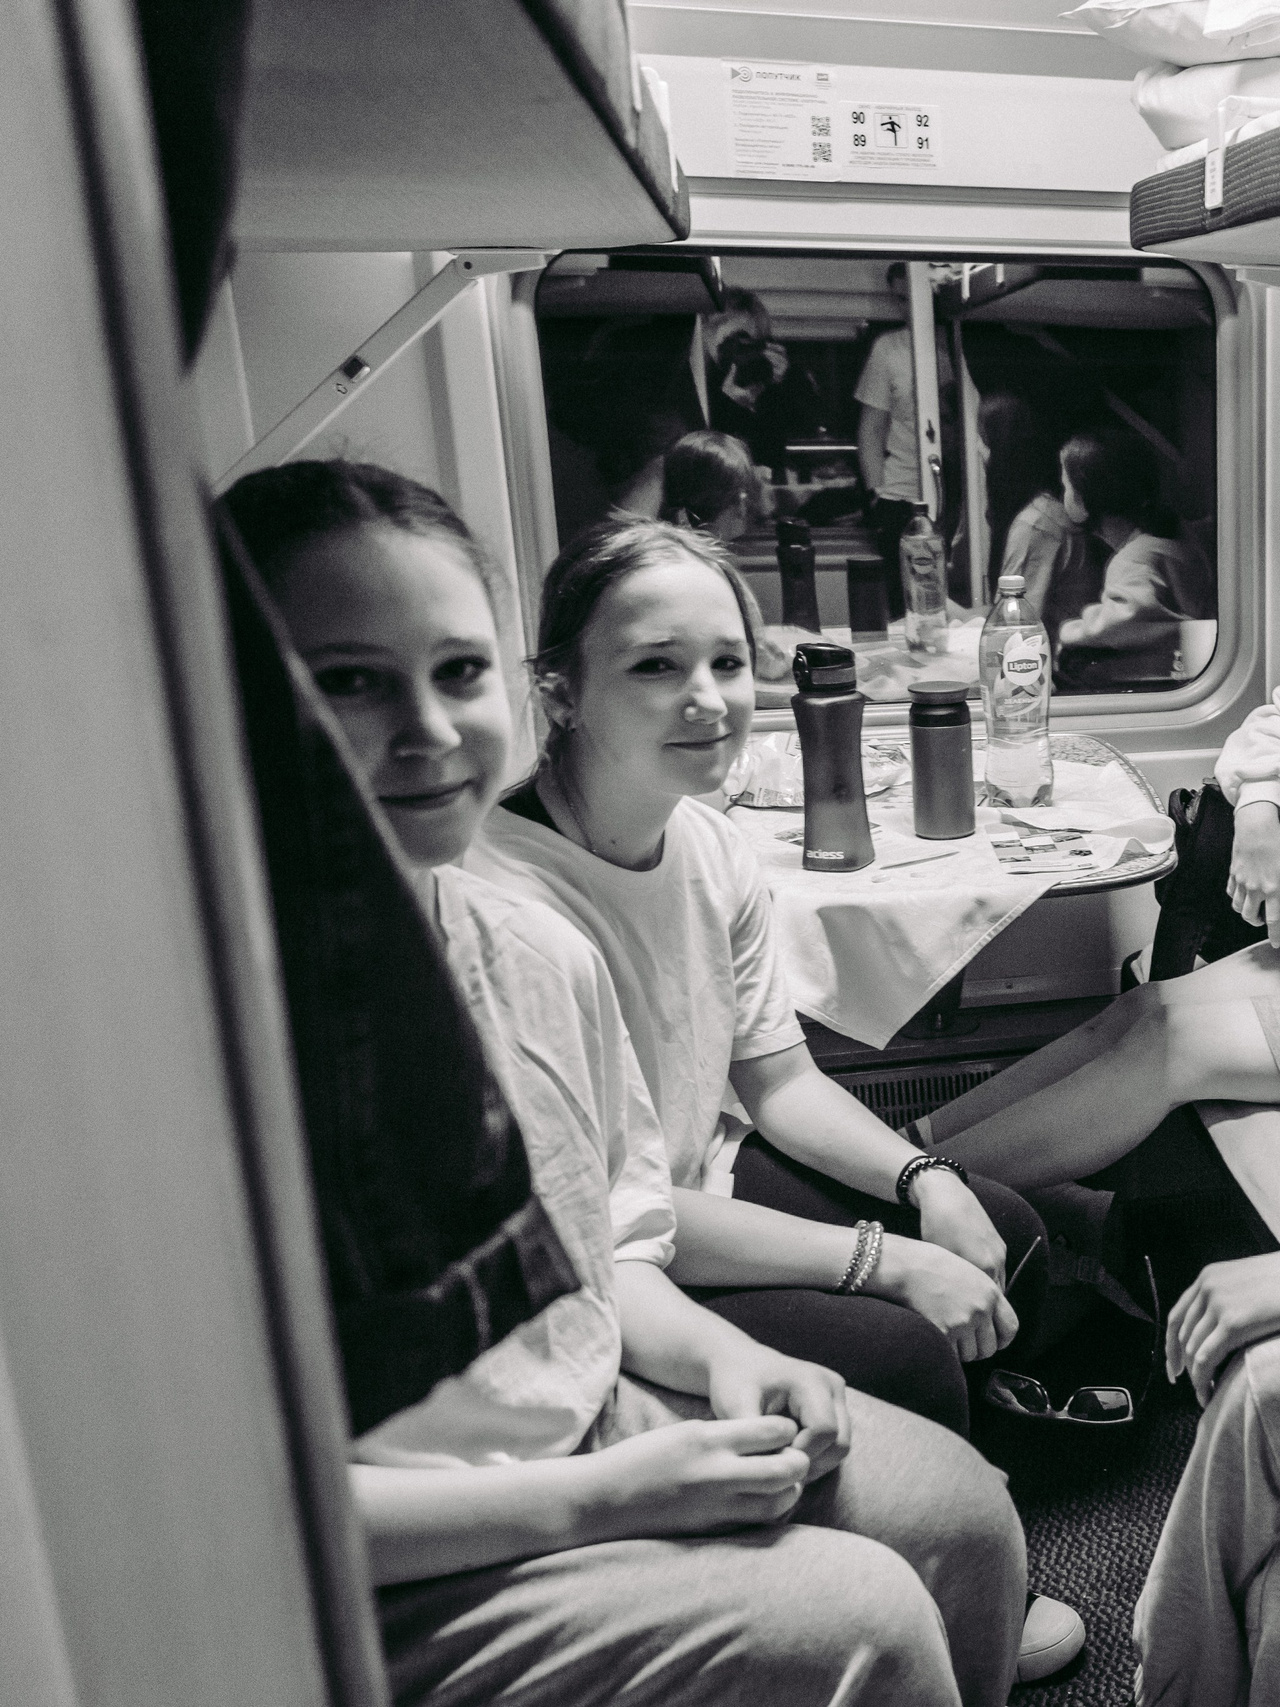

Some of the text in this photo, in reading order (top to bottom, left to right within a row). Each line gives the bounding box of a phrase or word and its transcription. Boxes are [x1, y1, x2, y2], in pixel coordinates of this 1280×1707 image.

[851, 111, 866, 125] 90
[916, 114, 930, 128] 92
[853, 134, 867, 147] 89
[916, 136, 930, 150] 91
[1009, 662, 1038, 672] Lipton
